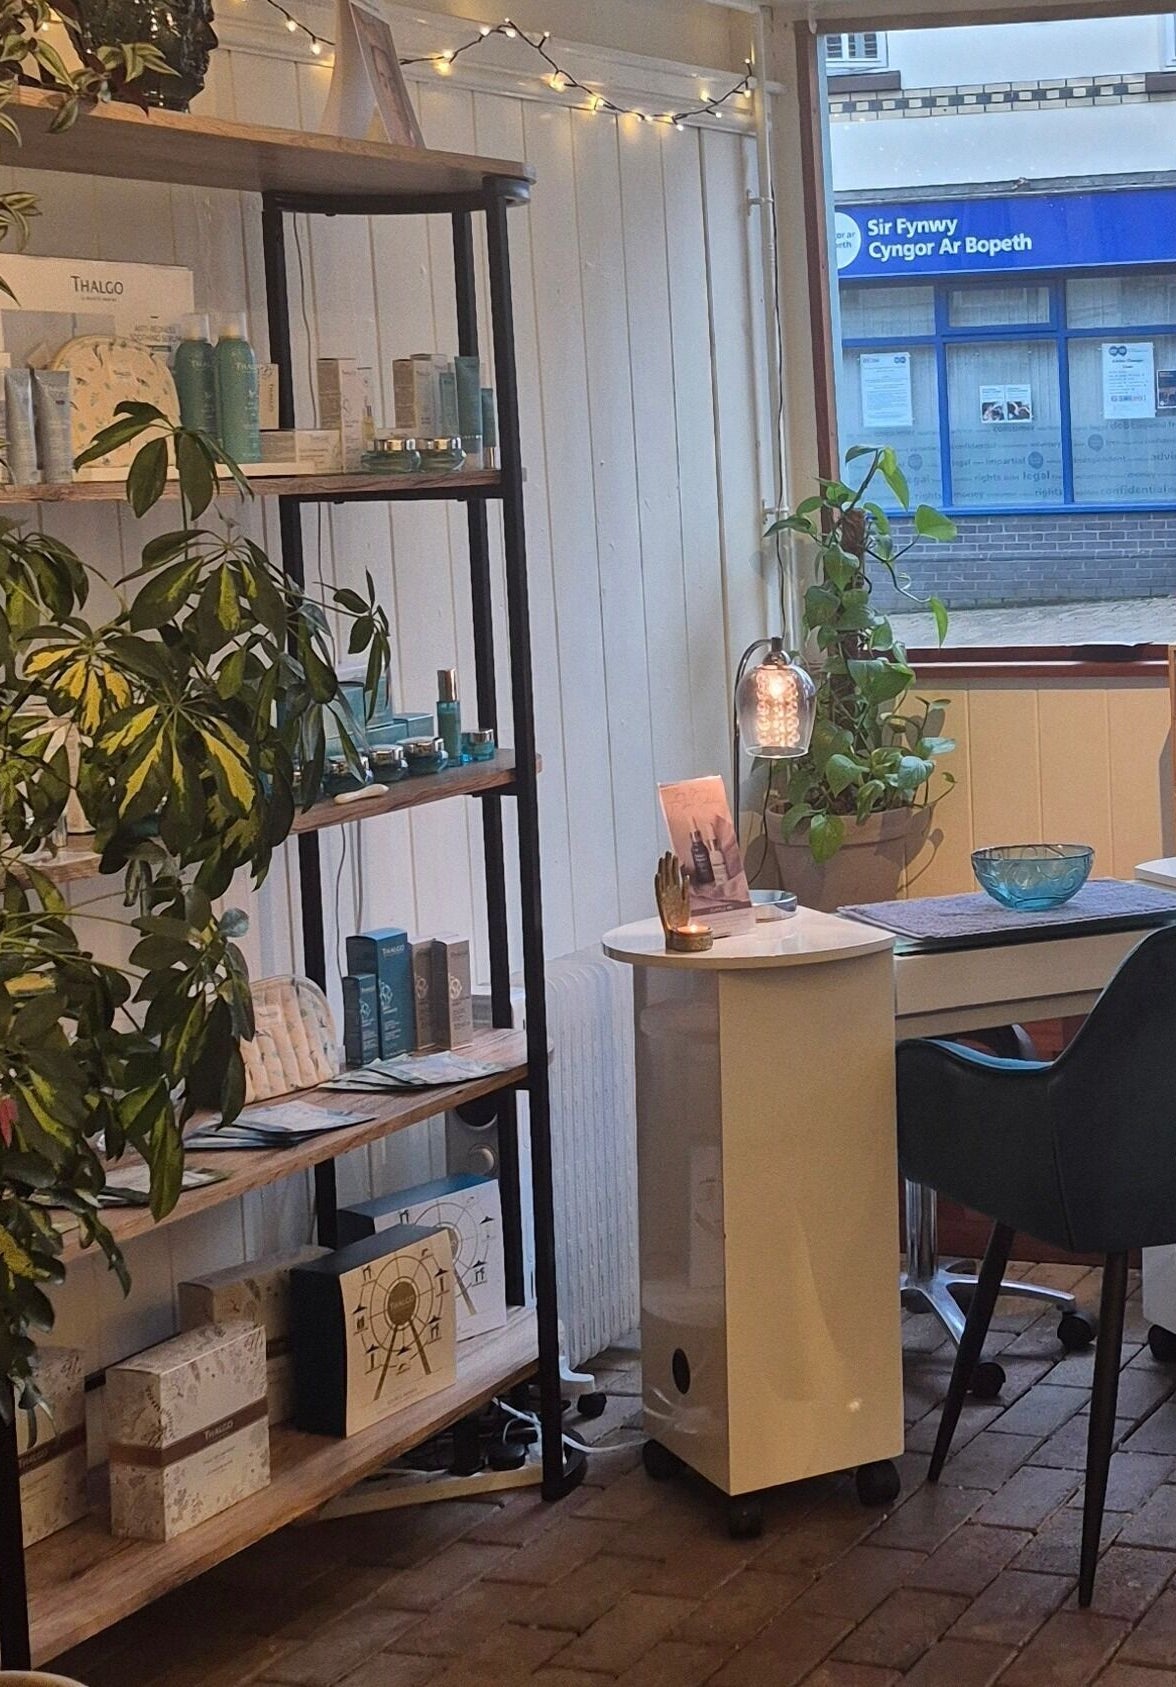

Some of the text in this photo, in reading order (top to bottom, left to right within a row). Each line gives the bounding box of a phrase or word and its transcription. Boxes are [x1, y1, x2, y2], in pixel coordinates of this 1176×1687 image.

[867, 218, 958, 238] Sir Fynwy
[868, 232, 1033, 262] Cyngor Ar Bopeth
[70, 275, 124, 295] THALGO
[1022, 470, 1050, 482] legal
[204, 1420, 234, 1441] THALGO
